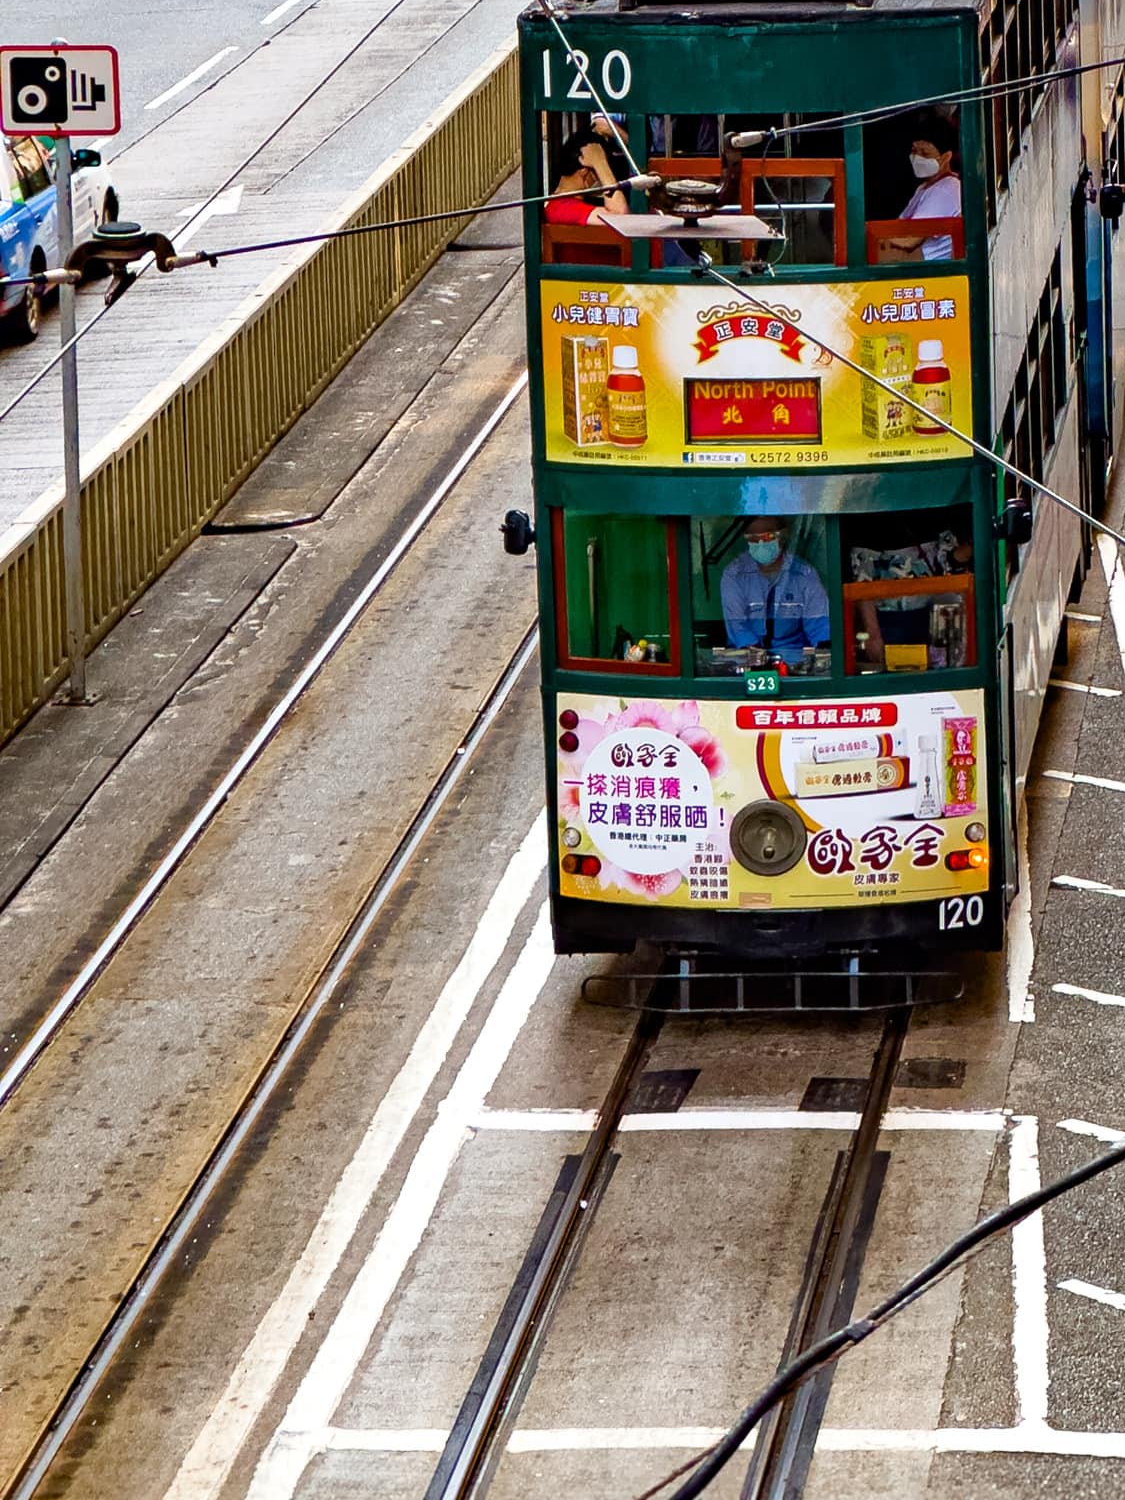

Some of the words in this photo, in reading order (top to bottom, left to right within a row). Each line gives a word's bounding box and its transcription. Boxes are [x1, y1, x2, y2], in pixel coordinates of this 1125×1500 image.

[542, 48, 632, 100] 120
[714, 318, 785, 342] 正安堂
[694, 380, 753, 399] North
[762, 380, 815, 399] Point
[722, 403, 790, 425] 北角
[759, 452, 791, 463] 2572
[796, 451, 828, 462] 9396
[748, 677, 775, 691] S23
[752, 708, 882, 725] 百年信賴品牌
[939, 895, 984, 930] 120
